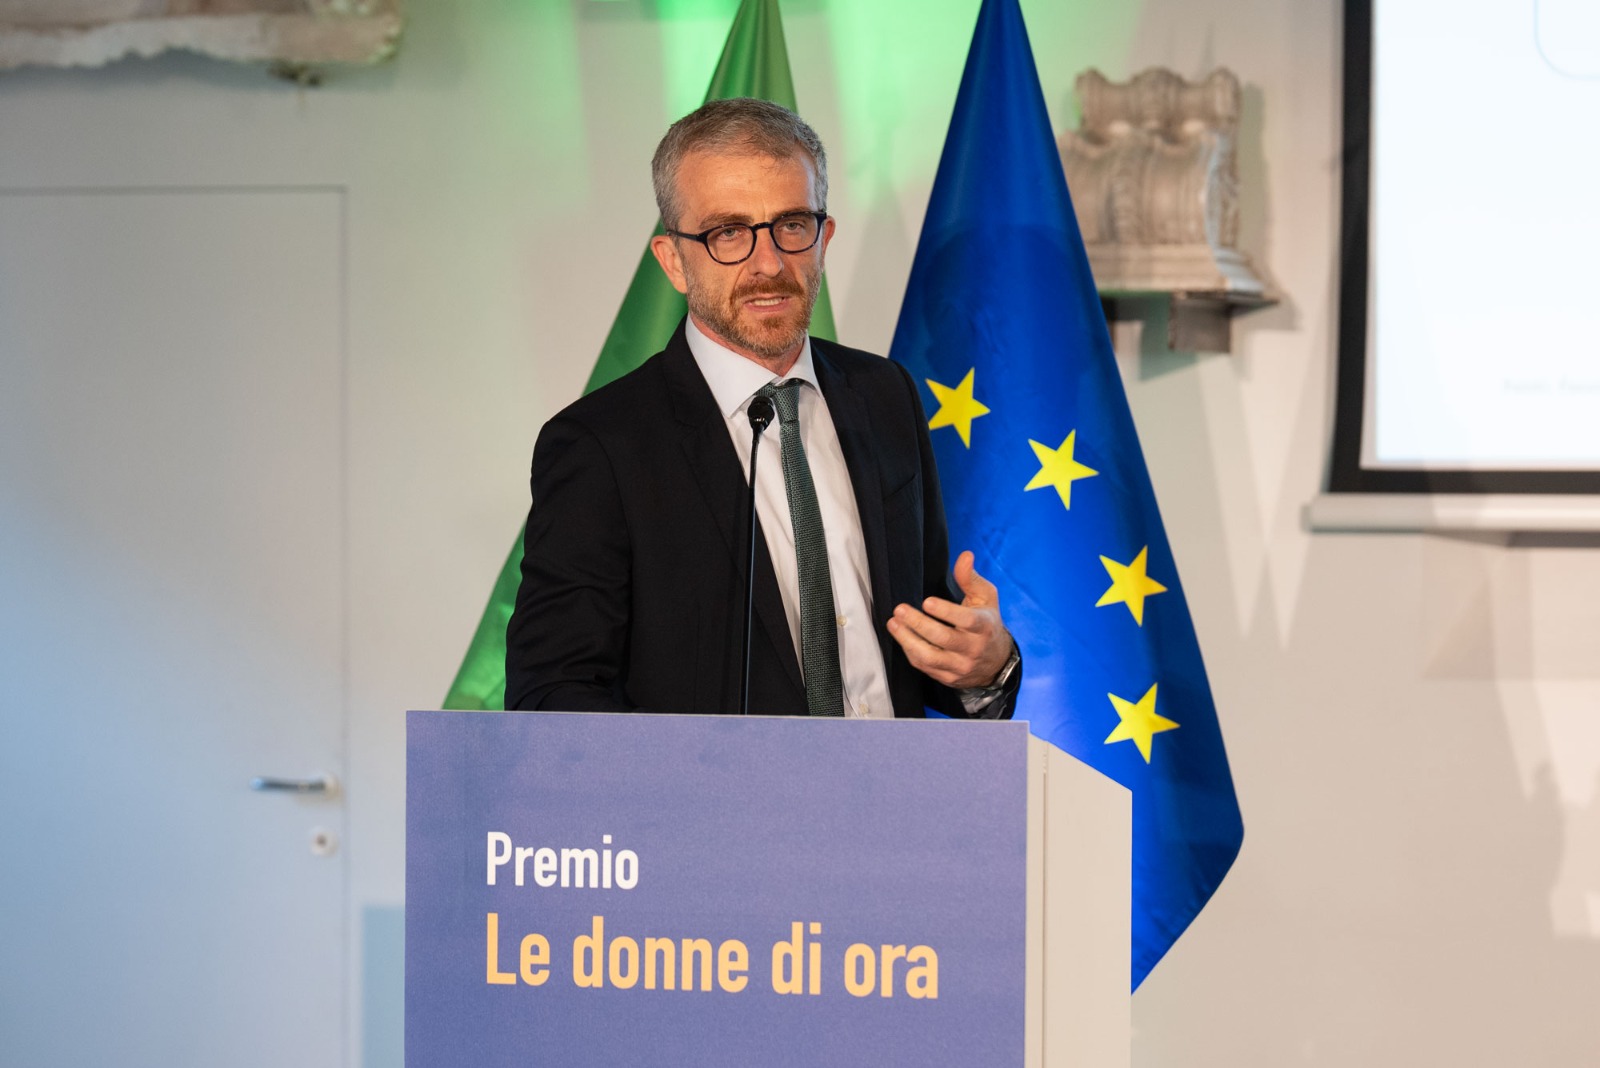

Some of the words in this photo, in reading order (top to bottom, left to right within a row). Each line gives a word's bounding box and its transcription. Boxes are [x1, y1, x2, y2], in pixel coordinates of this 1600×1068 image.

[486, 831, 639, 889] Premio
[486, 912, 551, 986] Le
[572, 915, 749, 993] donne
[771, 921, 822, 996] di
[843, 942, 939, 999] ora
